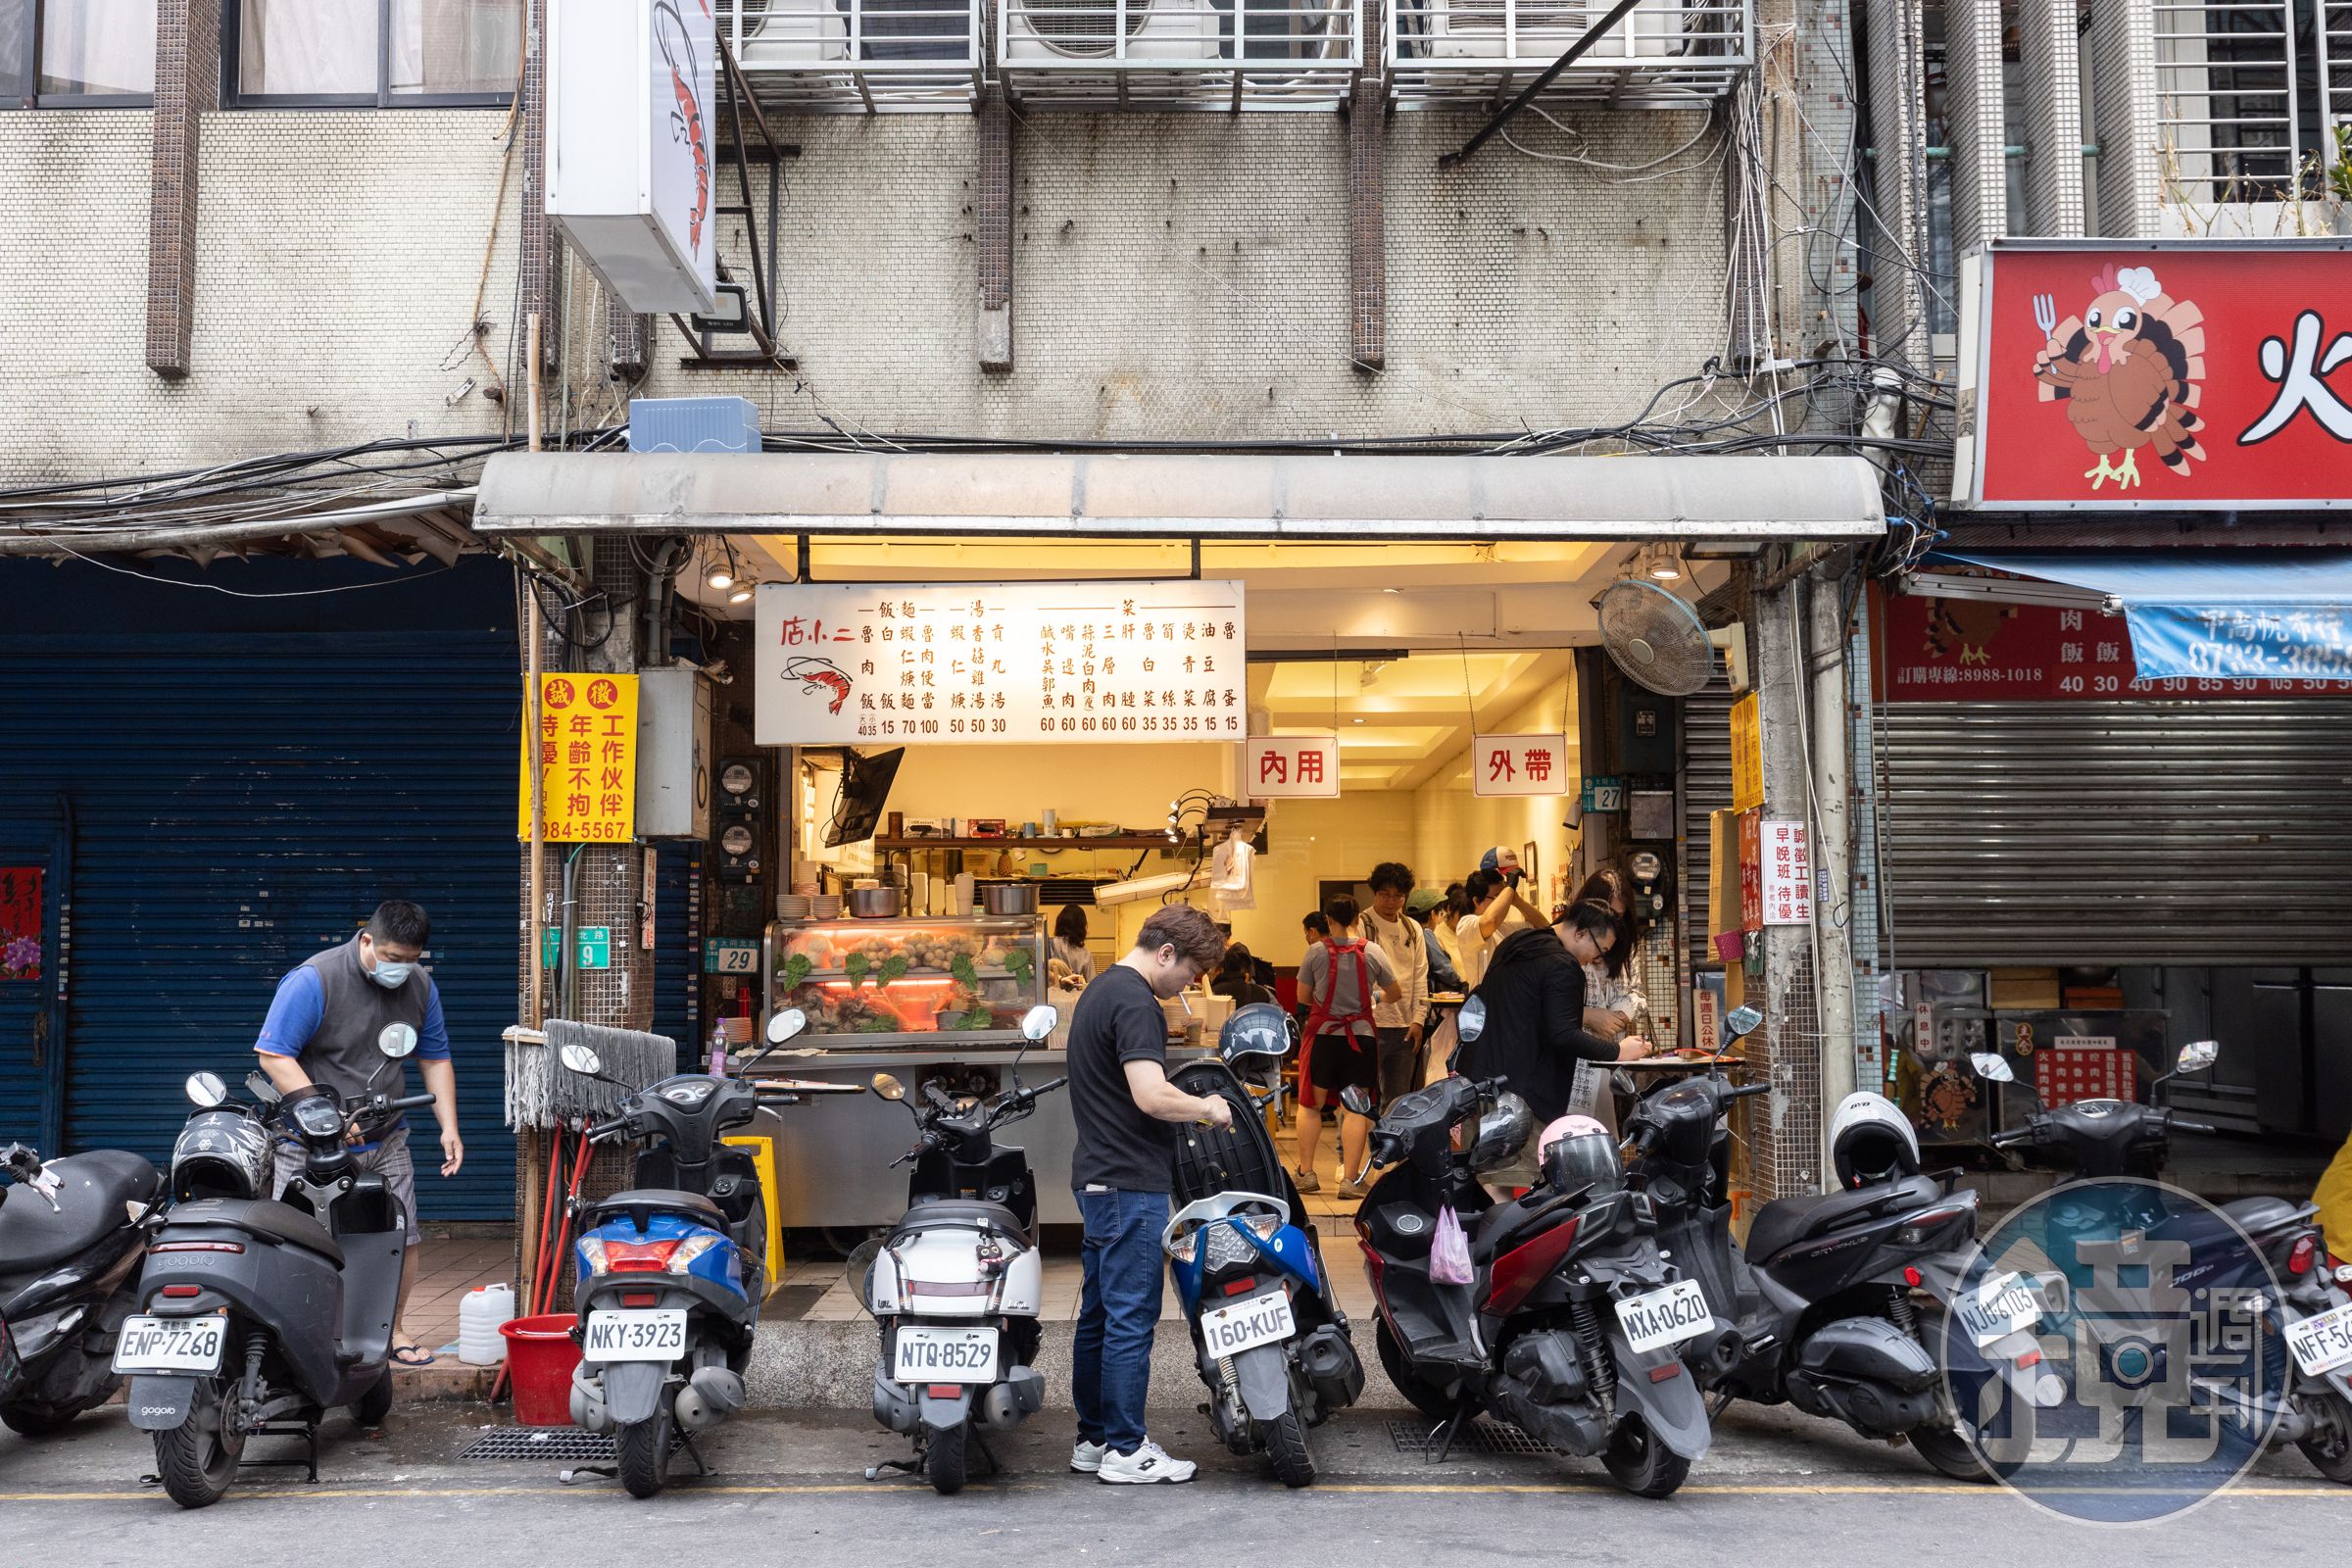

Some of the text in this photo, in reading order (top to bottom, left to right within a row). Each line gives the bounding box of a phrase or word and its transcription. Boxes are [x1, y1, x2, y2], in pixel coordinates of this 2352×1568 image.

[2236, 308, 2352, 449] 火
[970, 600, 984, 617] 湯
[1122, 599, 1136, 616] 菜
[781, 615, 856, 646] 店小二
[880, 626, 896, 710] 白飯
[991, 623, 1005, 710] 貢丸湯
[1102, 624, 1115, 708] 三層肉
[1201, 621, 1216, 708] 油豆腐
[548, 680, 614, 706] 誠徵
[2060, 676, 2084, 693] 40
[2094, 676, 2119, 692] 30
[2129, 677, 2153, 692] 40
[2163, 677, 2187, 692] 90
[2198, 677, 2224, 691] 85
[2232, 677, 2257, 691] 90
[2270, 678, 2292, 691] 105
[2303, 678, 2327, 690] 50
[858, 718, 1005, 736] 40 35 15 70 100 50 50 30
[1041, 716, 1238, 731] 60 60 60 60 60 35 35 35 15 15
[566, 713, 592, 817] 年齡不拘
[600, 714, 625, 817] 工作伙伴
[1260, 750, 1323, 784] 內用
[1489, 749, 1551, 782] 外帶
[1602, 790, 1619, 808] 27
[727, 951, 750, 969] 29
[1919, 1005, 1930, 1049] 休息中
[1209, 1306, 1288, 1350] 160-KUF
[1623, 1294, 1706, 1342] MXA-0620
[122, 1331, 218, 1357] ENP-7268
[590, 1322, 681, 1348] NKY-3923
[902, 1342, 992, 1368] NTQ-8529
[141, 1405, 176, 1416] gogoro
